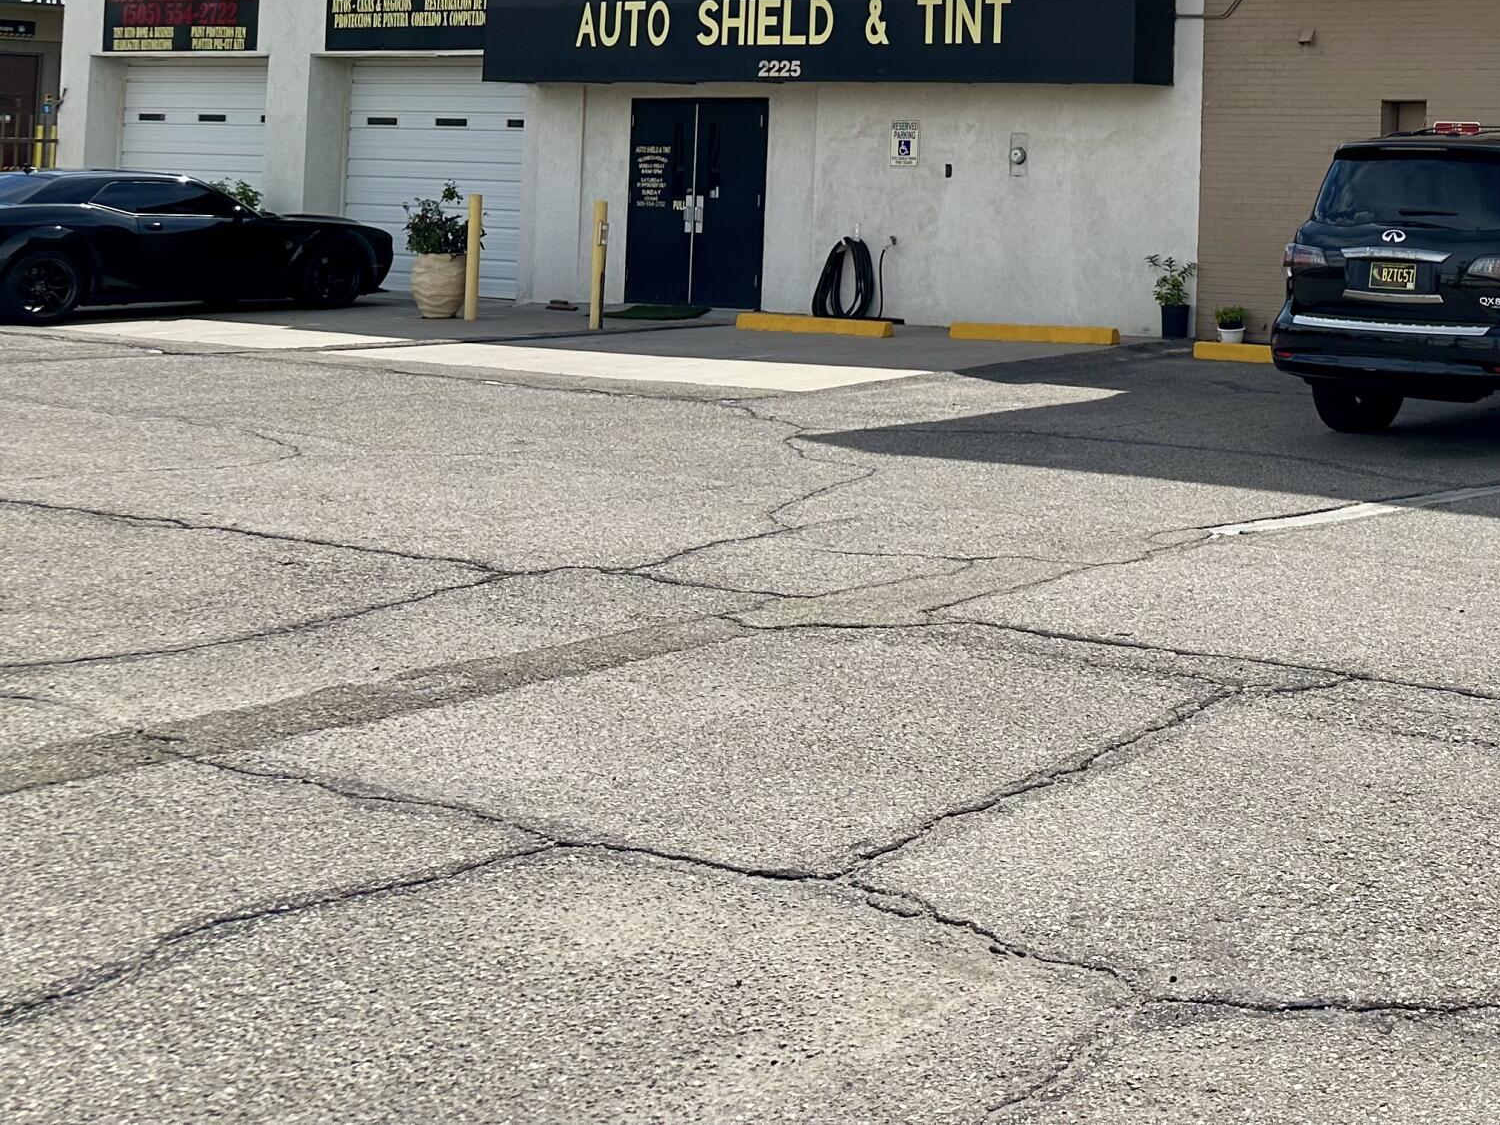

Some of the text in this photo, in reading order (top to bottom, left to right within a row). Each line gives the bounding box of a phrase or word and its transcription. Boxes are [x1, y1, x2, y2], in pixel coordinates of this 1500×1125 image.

[122, 1, 238, 24] (505) 554-2722
[334, 13, 372, 28] PROTECCION
[373, 12, 382, 28] DE
[383, 12, 409, 28] PINTURA
[411, 11, 441, 27] CORTADO
[442, 11, 448, 26] X
[575, 0, 671, 47] AUTO
[758, 60, 801, 77] 2225
[893, 122, 918, 130] RESERVED
[894, 131, 916, 139] PARKING
[673, 200, 687, 210] PULL
[1381, 268, 1414, 282] BZTC57
